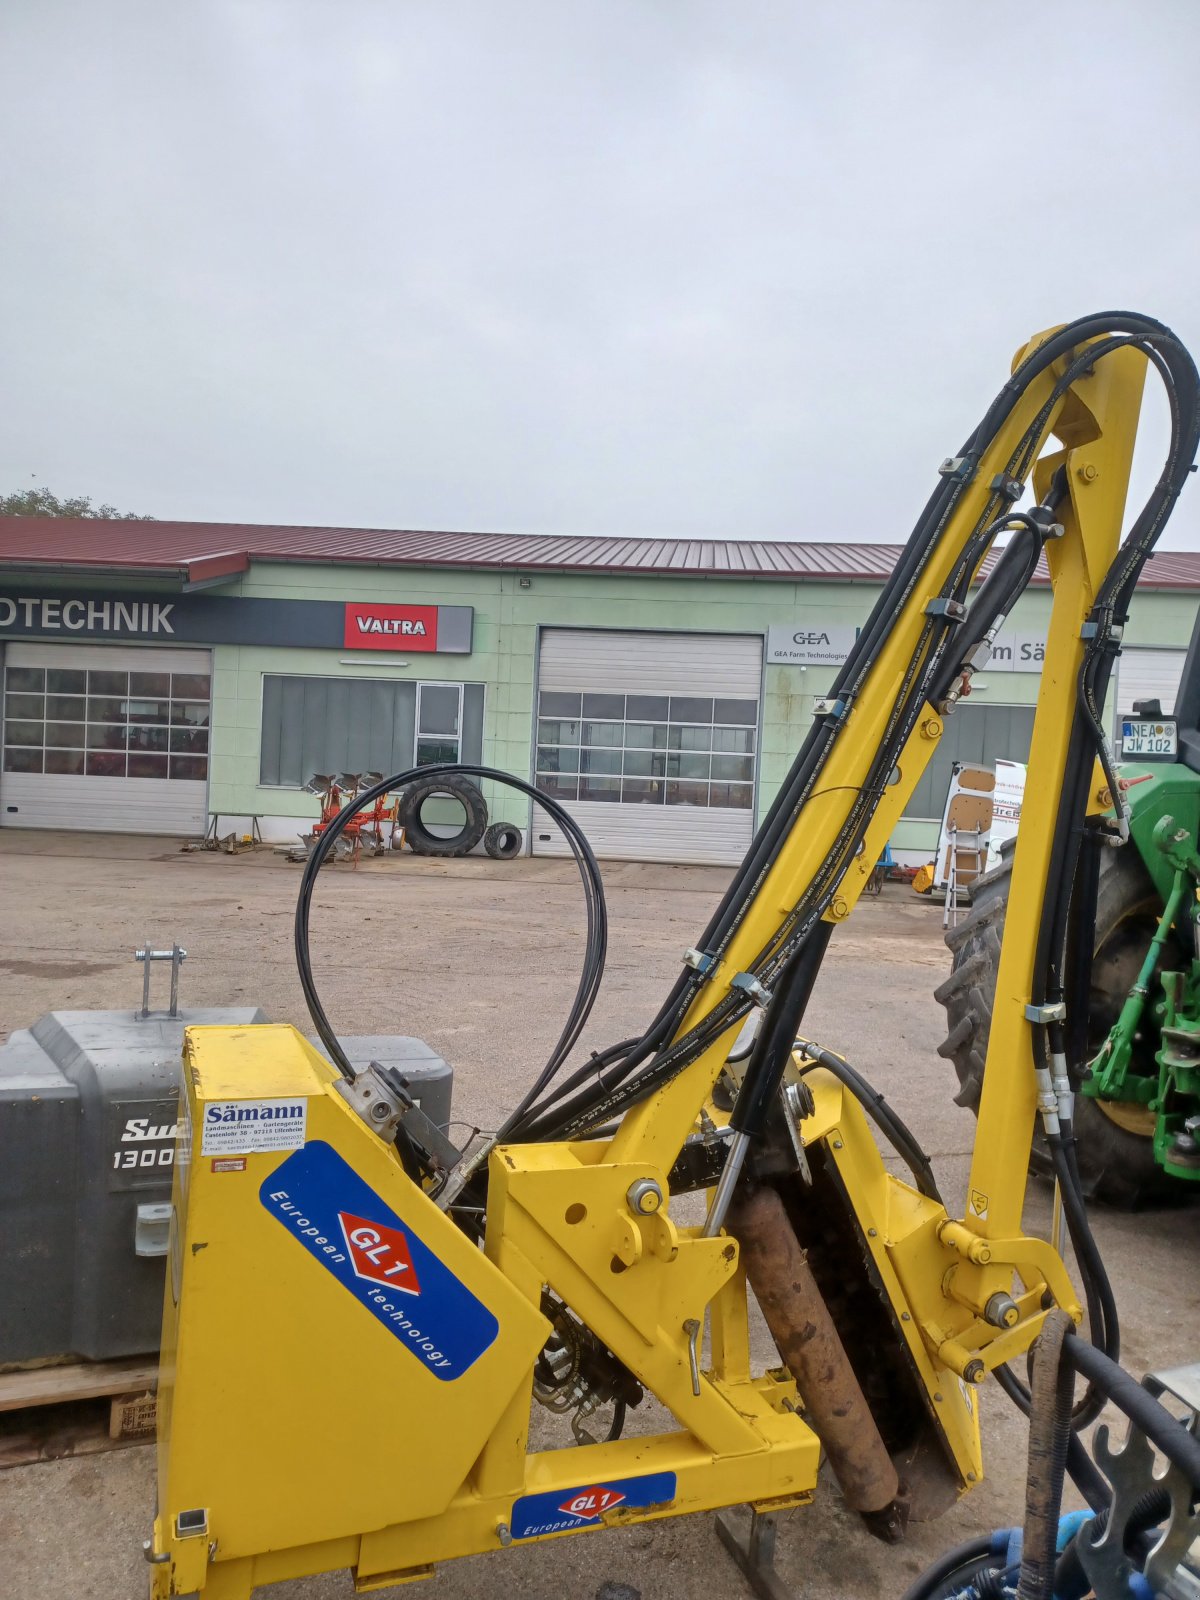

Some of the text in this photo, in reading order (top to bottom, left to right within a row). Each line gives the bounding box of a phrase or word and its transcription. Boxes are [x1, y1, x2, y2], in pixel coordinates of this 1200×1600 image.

[356, 616, 426, 635] VALTRA
[793, 632, 830, 645] GEA
[808, 652, 848, 660] Technologies
[1132, 725, 1156, 737] NEA
[1128, 738, 1170, 752] JW 102
[206, 1105, 302, 1124] Sämann
[206, 1124, 254, 1132] Landmaschinen
[270, 1190, 346, 1263] European
[368, 1288, 452, 1368] technology
[524, 1518, 582, 1536] European
